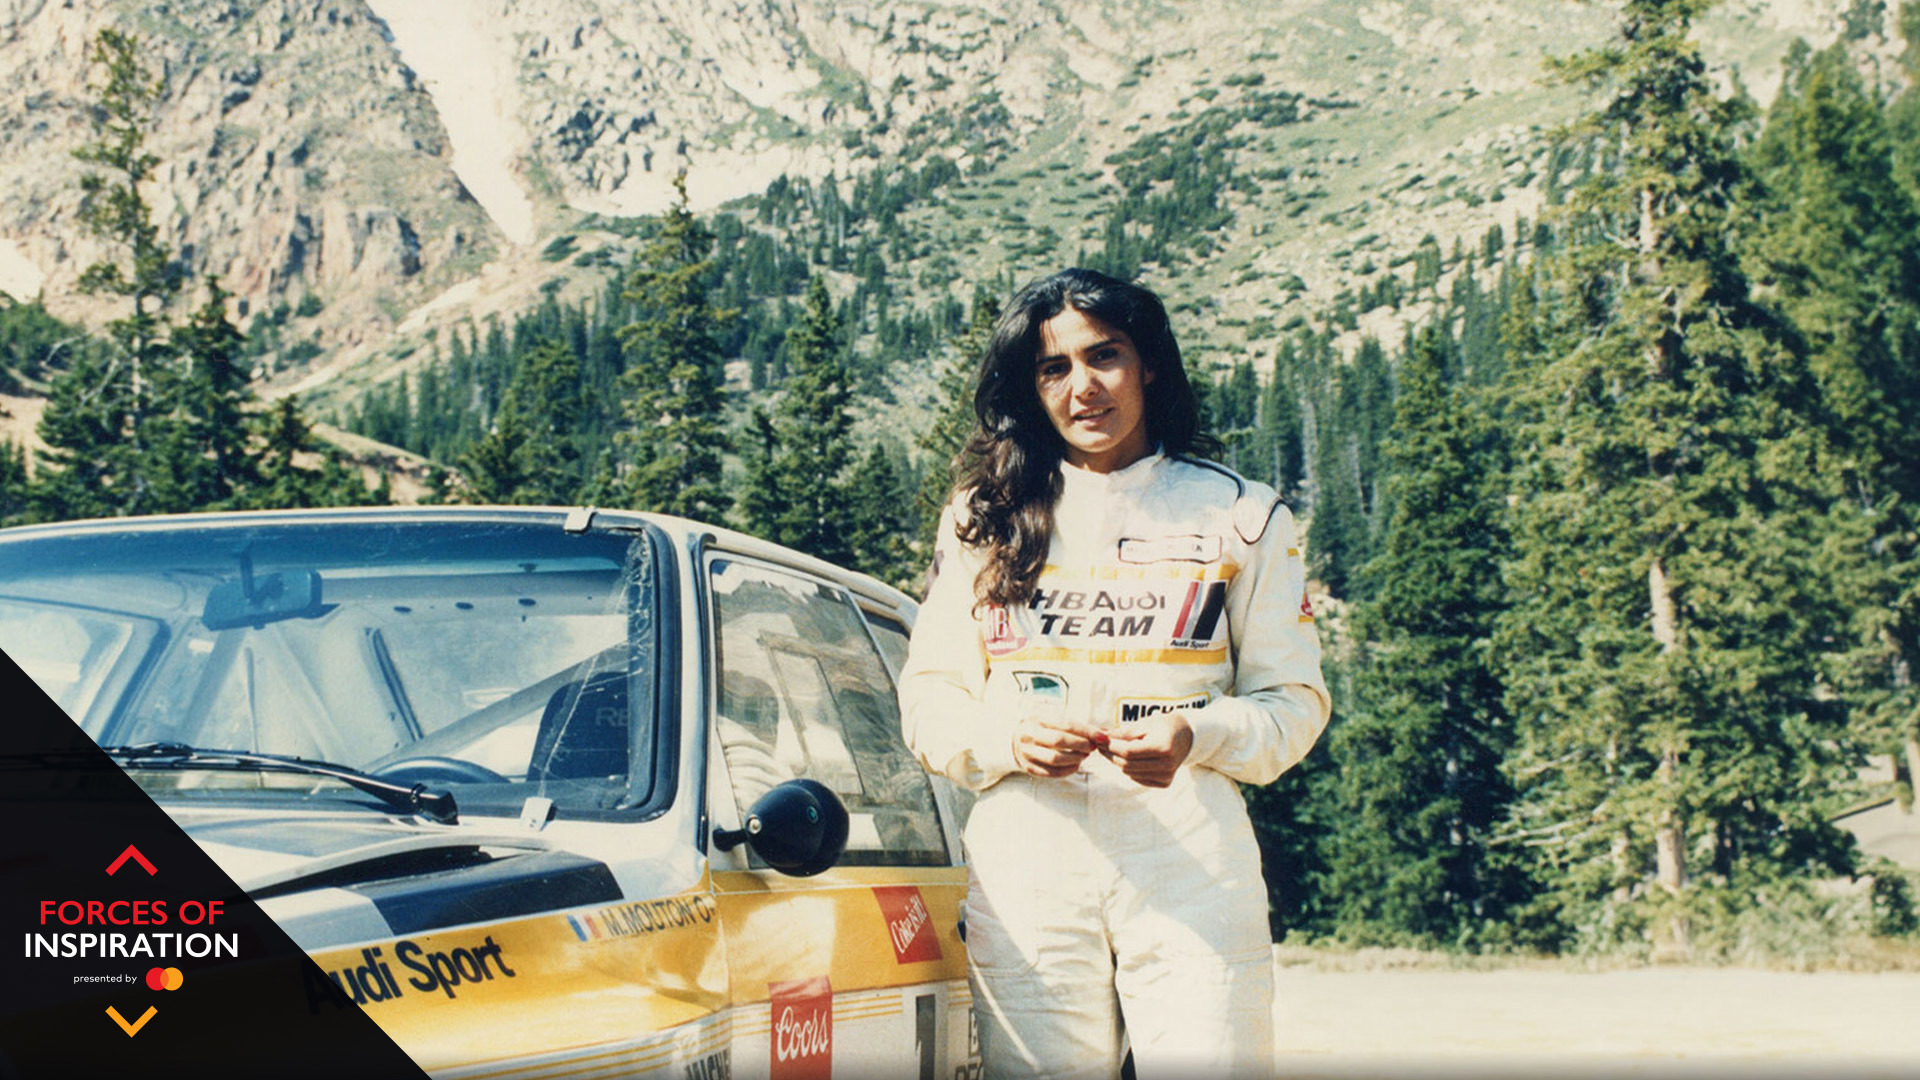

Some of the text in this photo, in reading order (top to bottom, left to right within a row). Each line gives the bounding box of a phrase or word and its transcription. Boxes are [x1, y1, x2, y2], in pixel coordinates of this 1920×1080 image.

[1028, 589, 1166, 612] HB Audi
[1040, 614, 1155, 637] TEAM
[1170, 639, 1210, 650] Audi Sport
[395, 935, 516, 999] Sport
[775, 1005, 830, 1062] Coors
